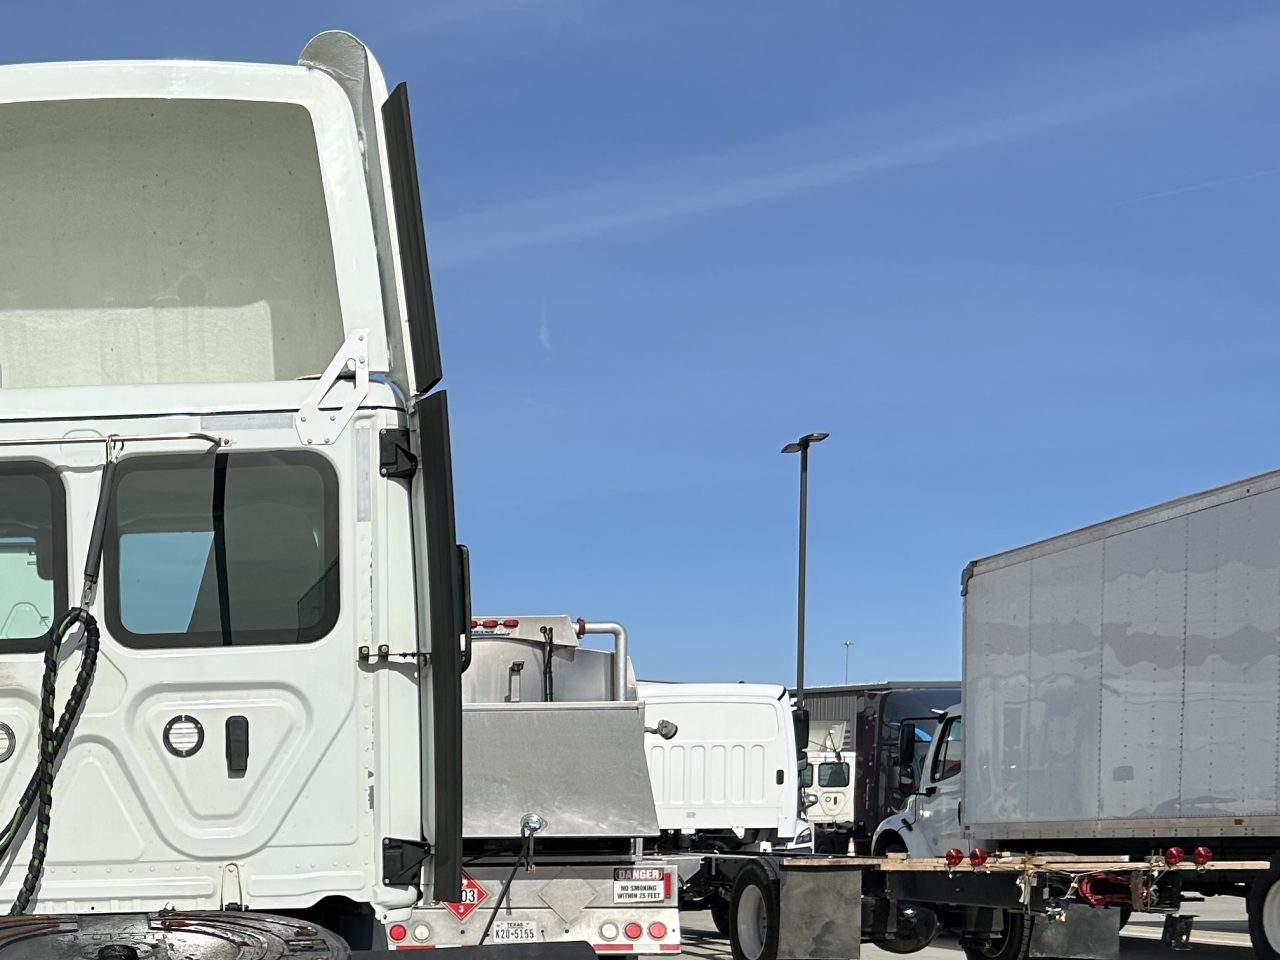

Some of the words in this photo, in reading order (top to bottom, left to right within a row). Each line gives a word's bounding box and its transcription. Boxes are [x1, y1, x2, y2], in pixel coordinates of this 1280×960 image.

[618, 869, 660, 880] DANGER
[461, 889, 476, 903] 03
[458, 905, 464, 913] 3
